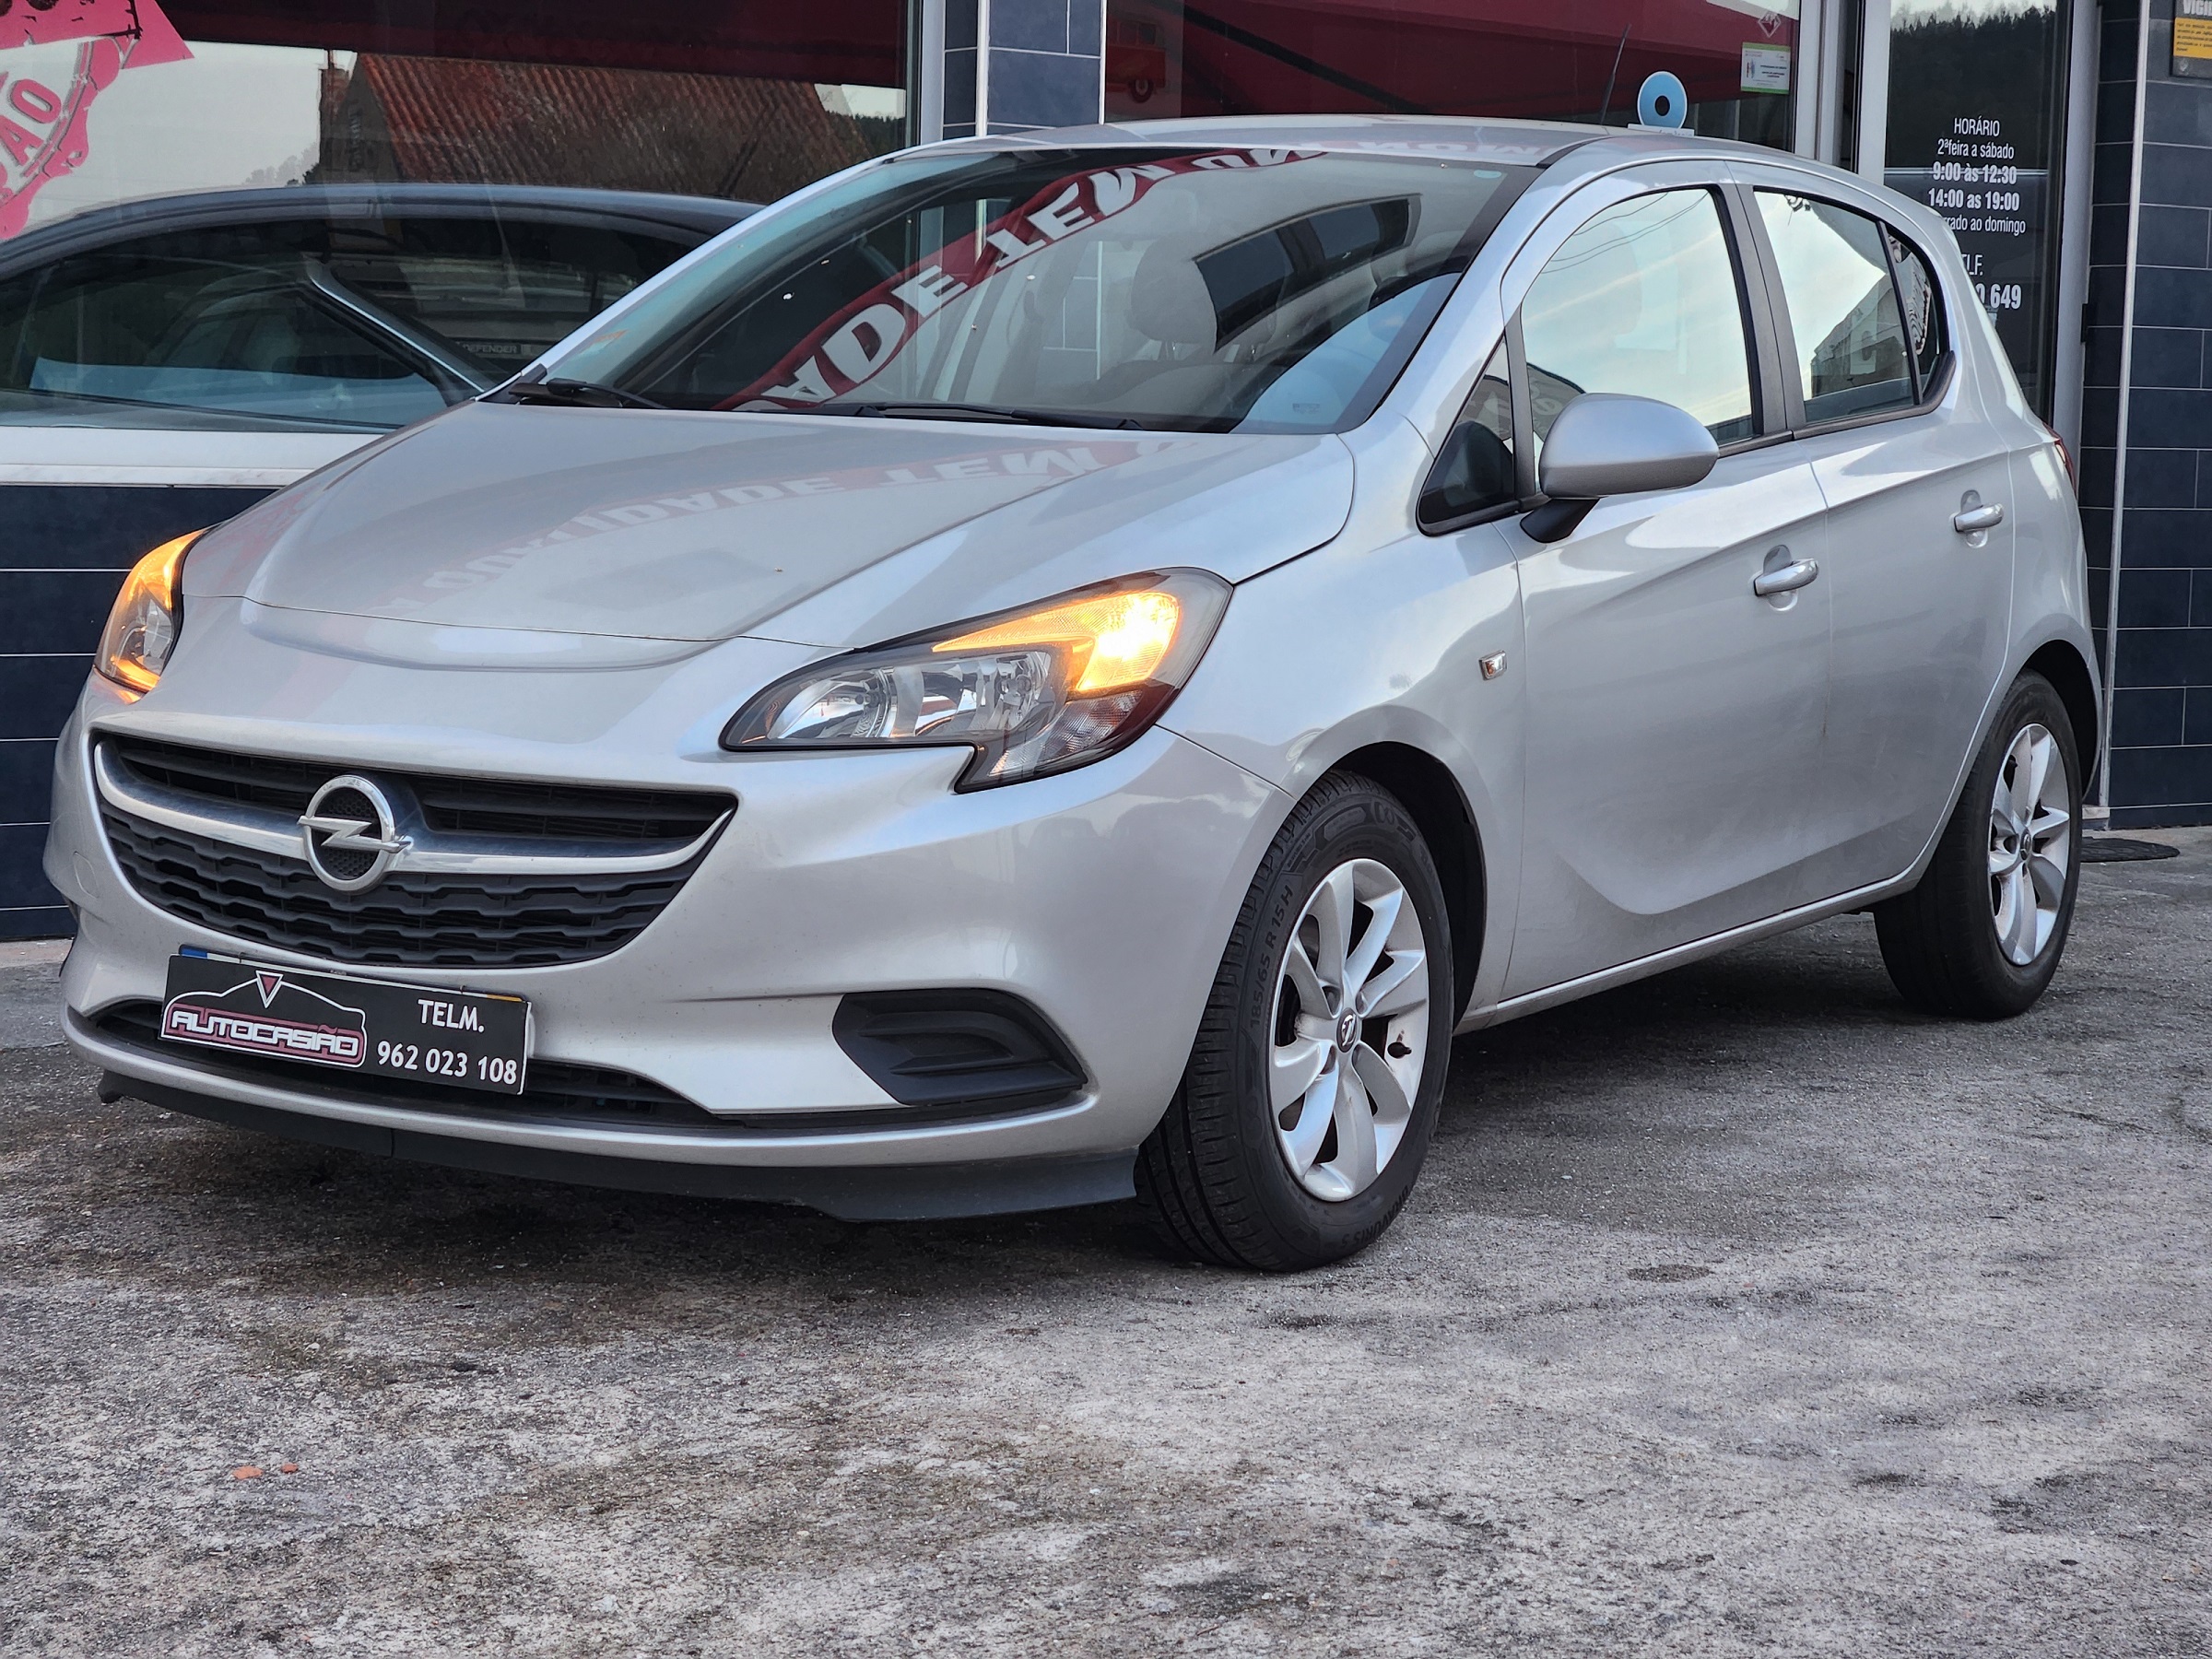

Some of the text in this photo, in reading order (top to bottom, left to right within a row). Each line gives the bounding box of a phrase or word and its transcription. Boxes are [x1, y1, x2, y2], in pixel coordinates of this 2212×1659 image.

[1953, 115, 2000, 136] HORÁRIO
[1937, 138, 2015, 159] 2ªfeira a sábado
[1933, 161, 2017, 184] 9:00 às 12:30
[1928, 188, 2019, 211] 14:00 as 19:00
[1971, 218, 1982, 230] ao
[1984, 216, 2026, 237] domingo
[1991, 283, 2021, 309] 649
[1249, 952, 1271, 1030] 185/65
[418, 998, 485, 1033] TELM.
[171, 1010, 360, 1057] AUTOCASIÃO
[376, 1041, 518, 1085] 962 023 108
